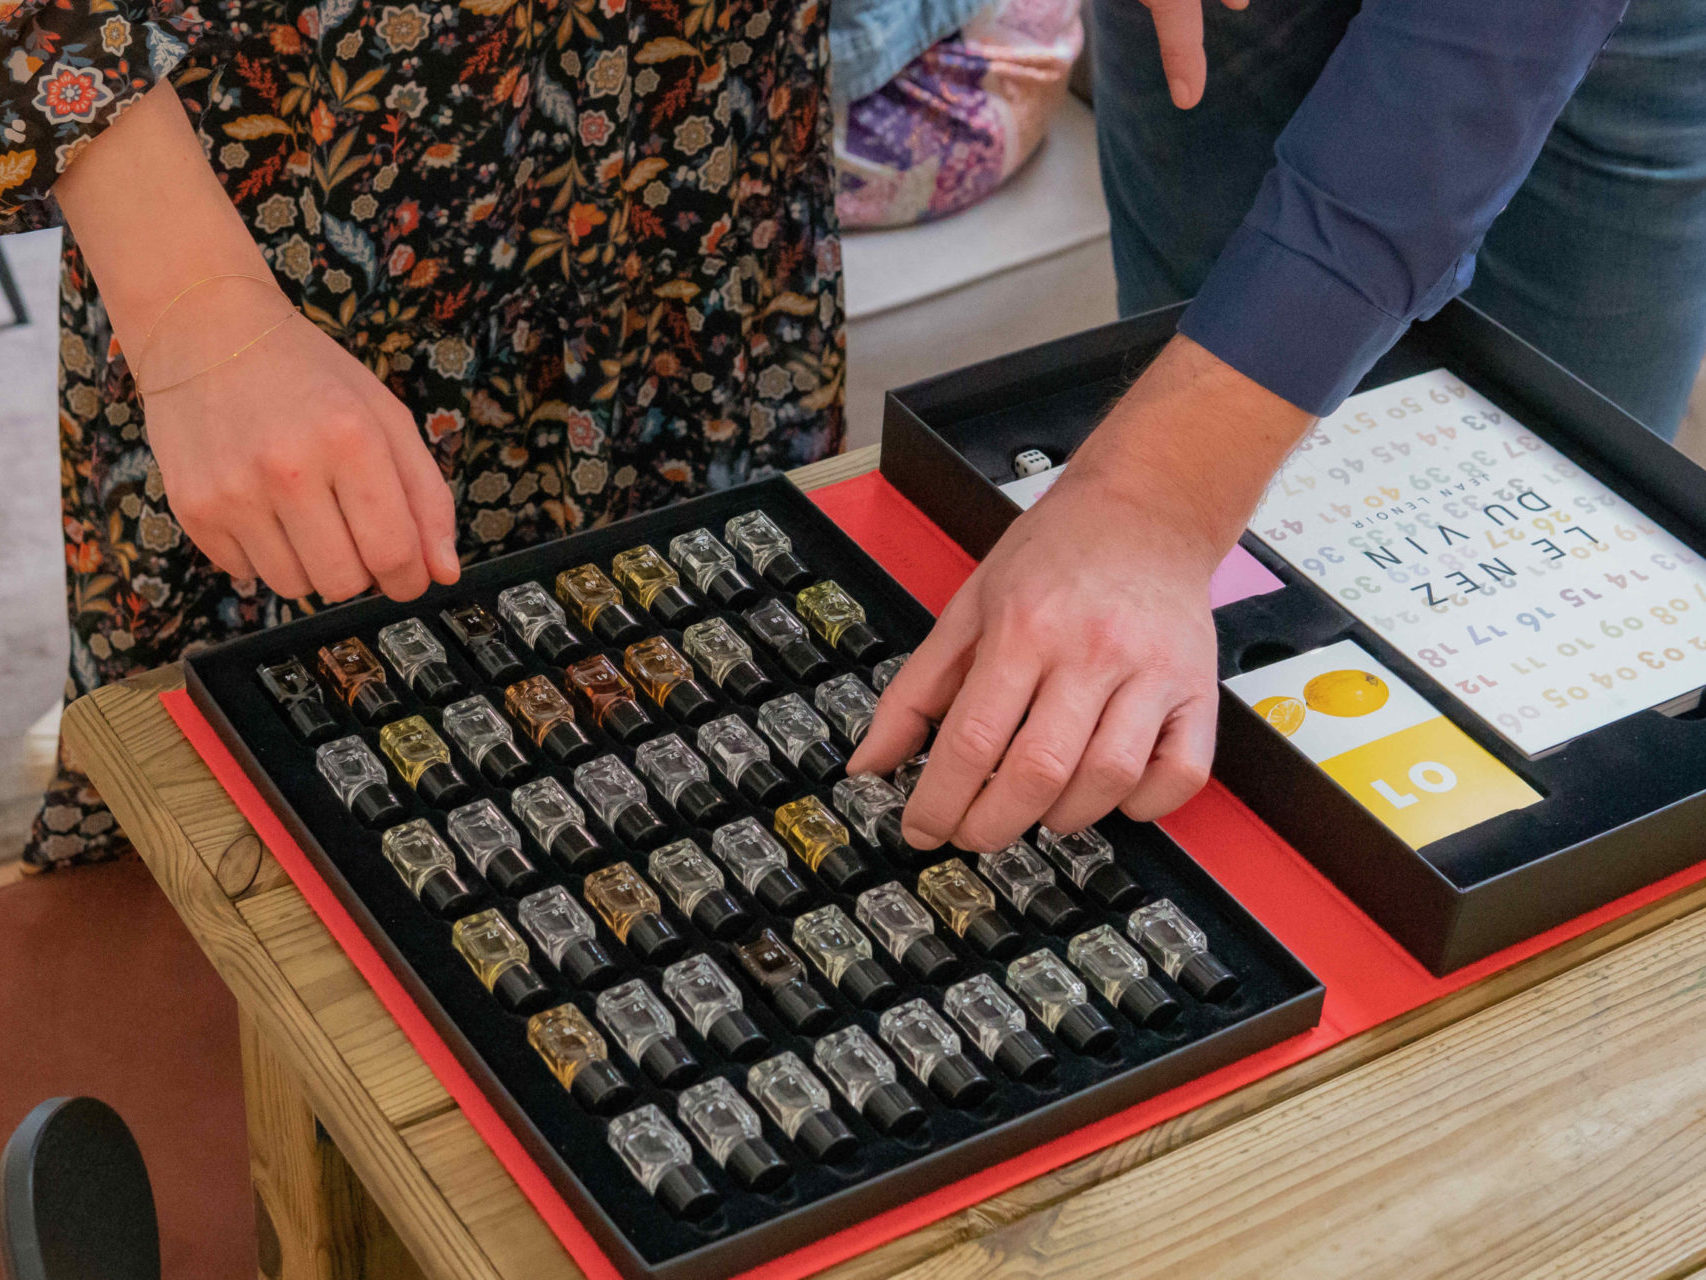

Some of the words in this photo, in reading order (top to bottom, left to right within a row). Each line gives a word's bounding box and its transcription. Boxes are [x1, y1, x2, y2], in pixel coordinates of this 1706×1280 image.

[1429, 385, 1467, 404] 49
[1387, 397, 1423, 419] 50
[1343, 412, 1377, 435] 51
[1462, 411, 1500, 431] 43
[1416, 425, 1457, 447] 44
[1502, 435, 1542, 459] 37
[1371, 441, 1411, 463] 45
[1328, 458, 1364, 486] 46
[1458, 450, 1497, 479] 38
[1280, 475, 1316, 497] 47
[1408, 466, 1451, 491] 39
[1440, 473, 1490, 498] JEAN
[1492, 478, 1534, 502] 32
[1363, 486, 1401, 509] 40
[1442, 494, 1482, 519] 33
[1483, 491, 1552, 526] DU
[1573, 493, 1616, 514] 25
[1317, 502, 1352, 524] 41
[1352, 497, 1431, 529] LENOIR
[1532, 511, 1572, 536] 26
[1263, 518, 1304, 542] 42
[1348, 529, 1393, 551] 35
[1484, 528, 1525, 550] 27
[1614, 524, 1656, 542] 19
[1363, 525, 1470, 570] VIN
[1531, 527, 1599, 561] LE
[1570, 542, 1610, 560] 20
[1302, 546, 1345, 577] 36
[1387, 562, 1430, 584] 29
[1650, 552, 1698, 571] 13
[1339, 575, 1381, 601] 30
[1410, 557, 1517, 607] NEZ
[1603, 569, 1649, 590] 14
[1559, 588, 1603, 608] 15
[1374, 611, 1420, 632] 24
[1516, 607, 1556, 632] 16
[1649, 598, 1690, 625] 08
[1466, 625, 1508, 646] 17
[1600, 616, 1644, 639] 09
[1417, 643, 1459, 668] 18
[1556, 637, 1596, 657] 10
[1637, 647, 1685, 670] 03
[1510, 656, 1548, 675] 11
[1455, 674, 1498, 695] 12
[1589, 667, 1637, 690] 04
[1542, 686, 1589, 709] 05
[1496, 705, 1541, 735] 06
[1370, 761, 1458, 810] 01
